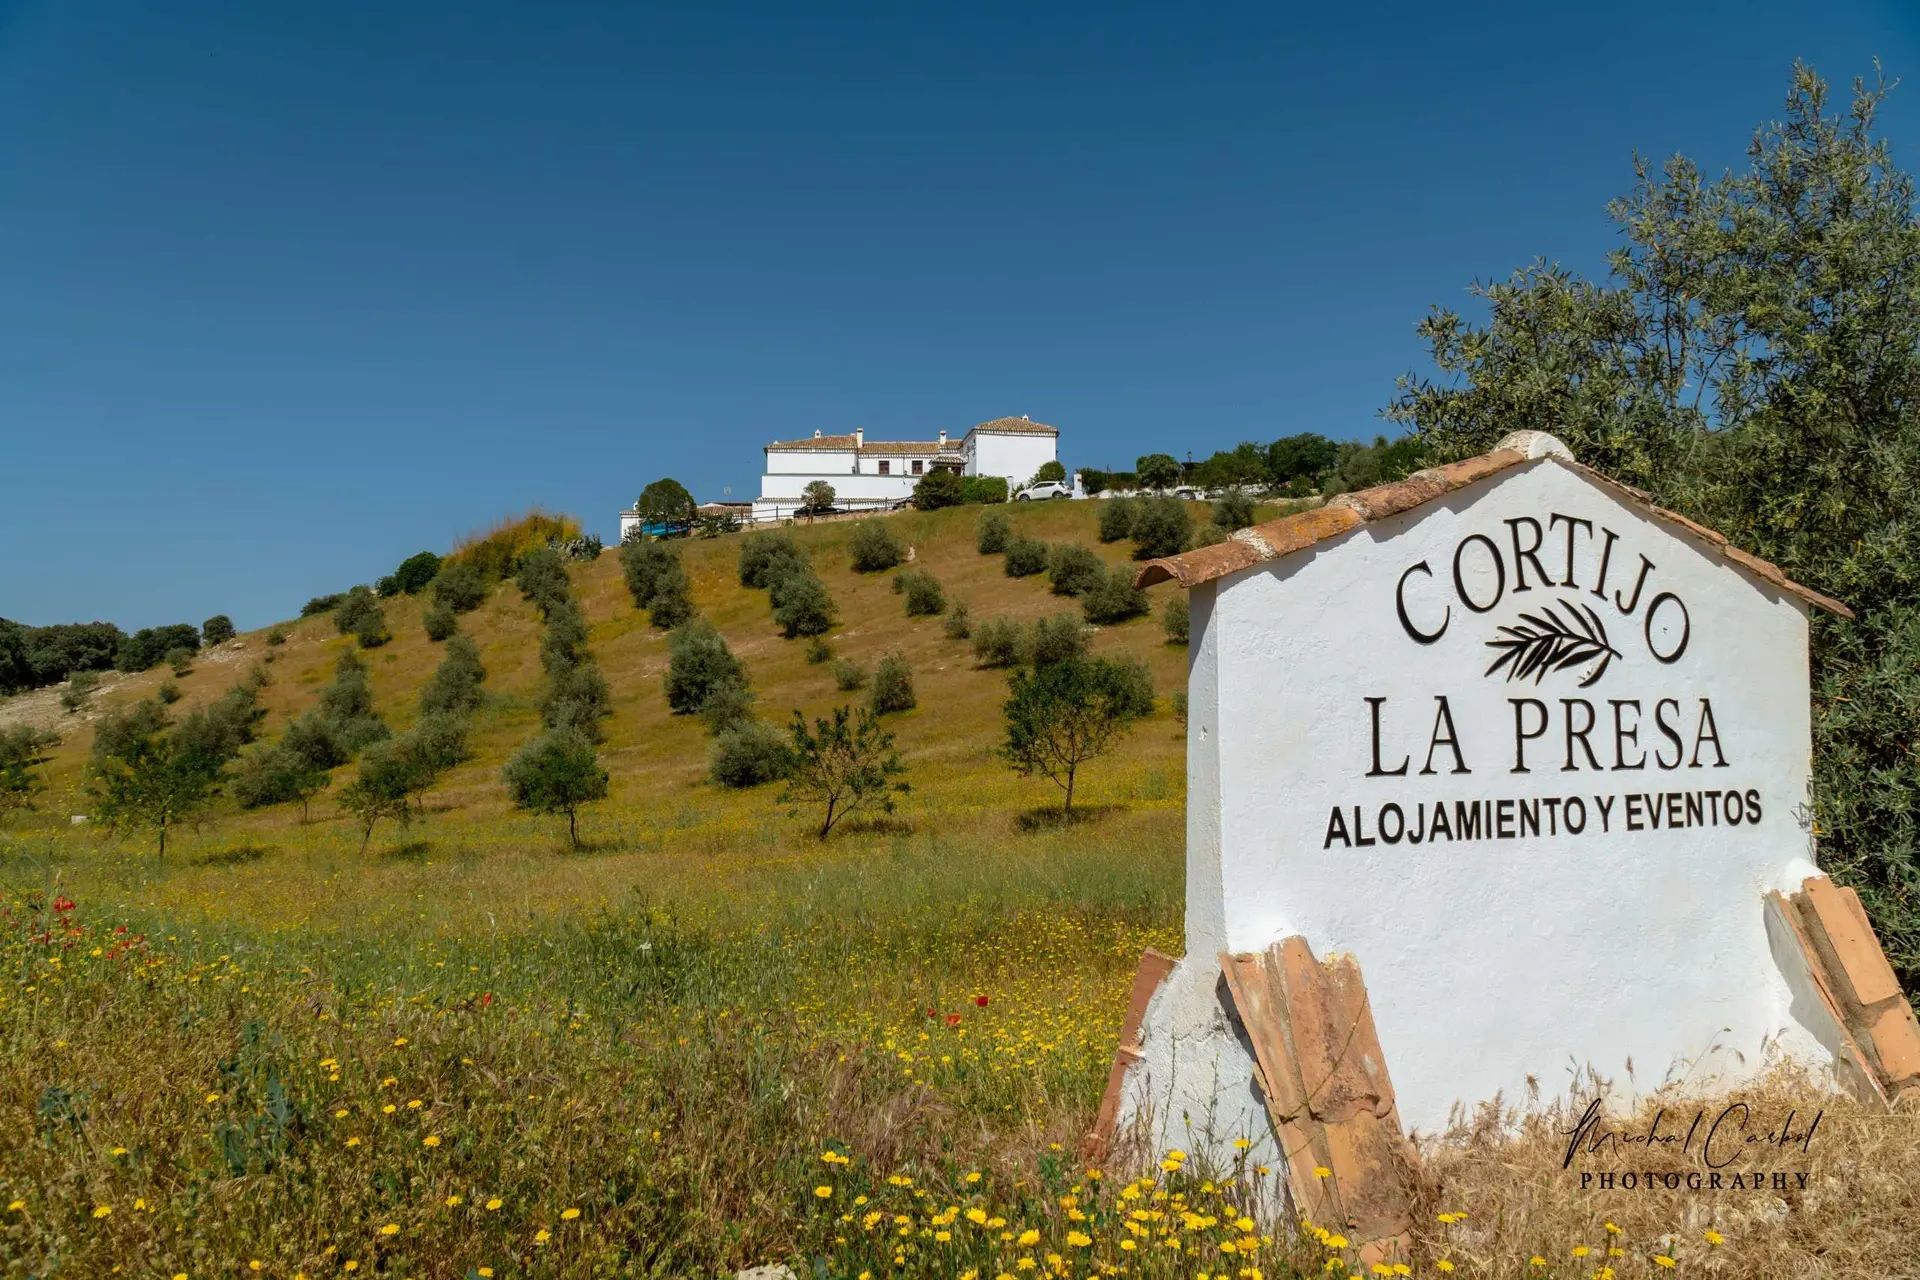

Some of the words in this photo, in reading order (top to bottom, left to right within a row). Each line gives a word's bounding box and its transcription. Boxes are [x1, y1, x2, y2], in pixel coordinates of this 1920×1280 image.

[1396, 512, 1691, 665] CORTIJO
[1363, 695, 1472, 778] LA
[1507, 697, 1730, 773] PRESA
[1323, 797, 1587, 850] ALOJAMIENTO
[1594, 795, 1615, 832] Y
[1625, 788, 1763, 831] EVENTOS
